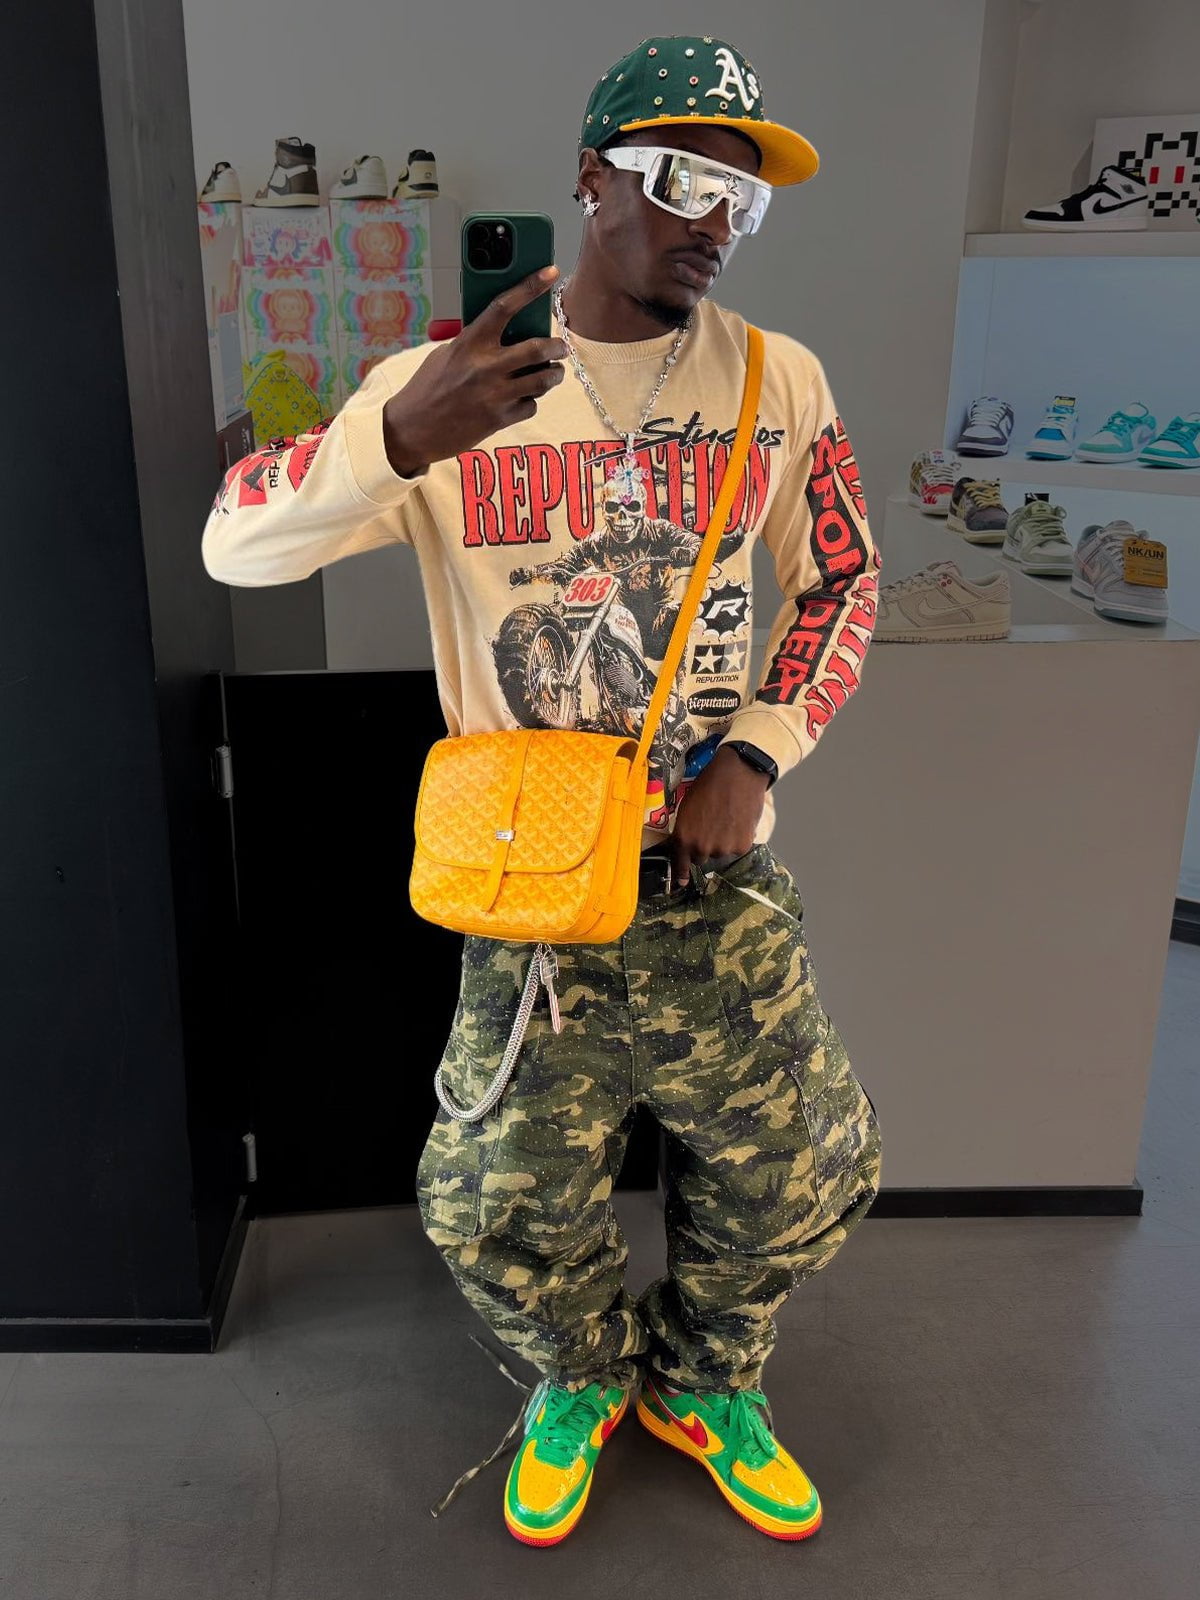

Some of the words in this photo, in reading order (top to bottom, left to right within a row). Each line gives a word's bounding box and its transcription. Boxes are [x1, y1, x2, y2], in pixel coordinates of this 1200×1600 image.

[565, 576, 611, 602] 303
[695, 674, 739, 684] REPUTATION
[688, 696, 738, 710] Reputation
